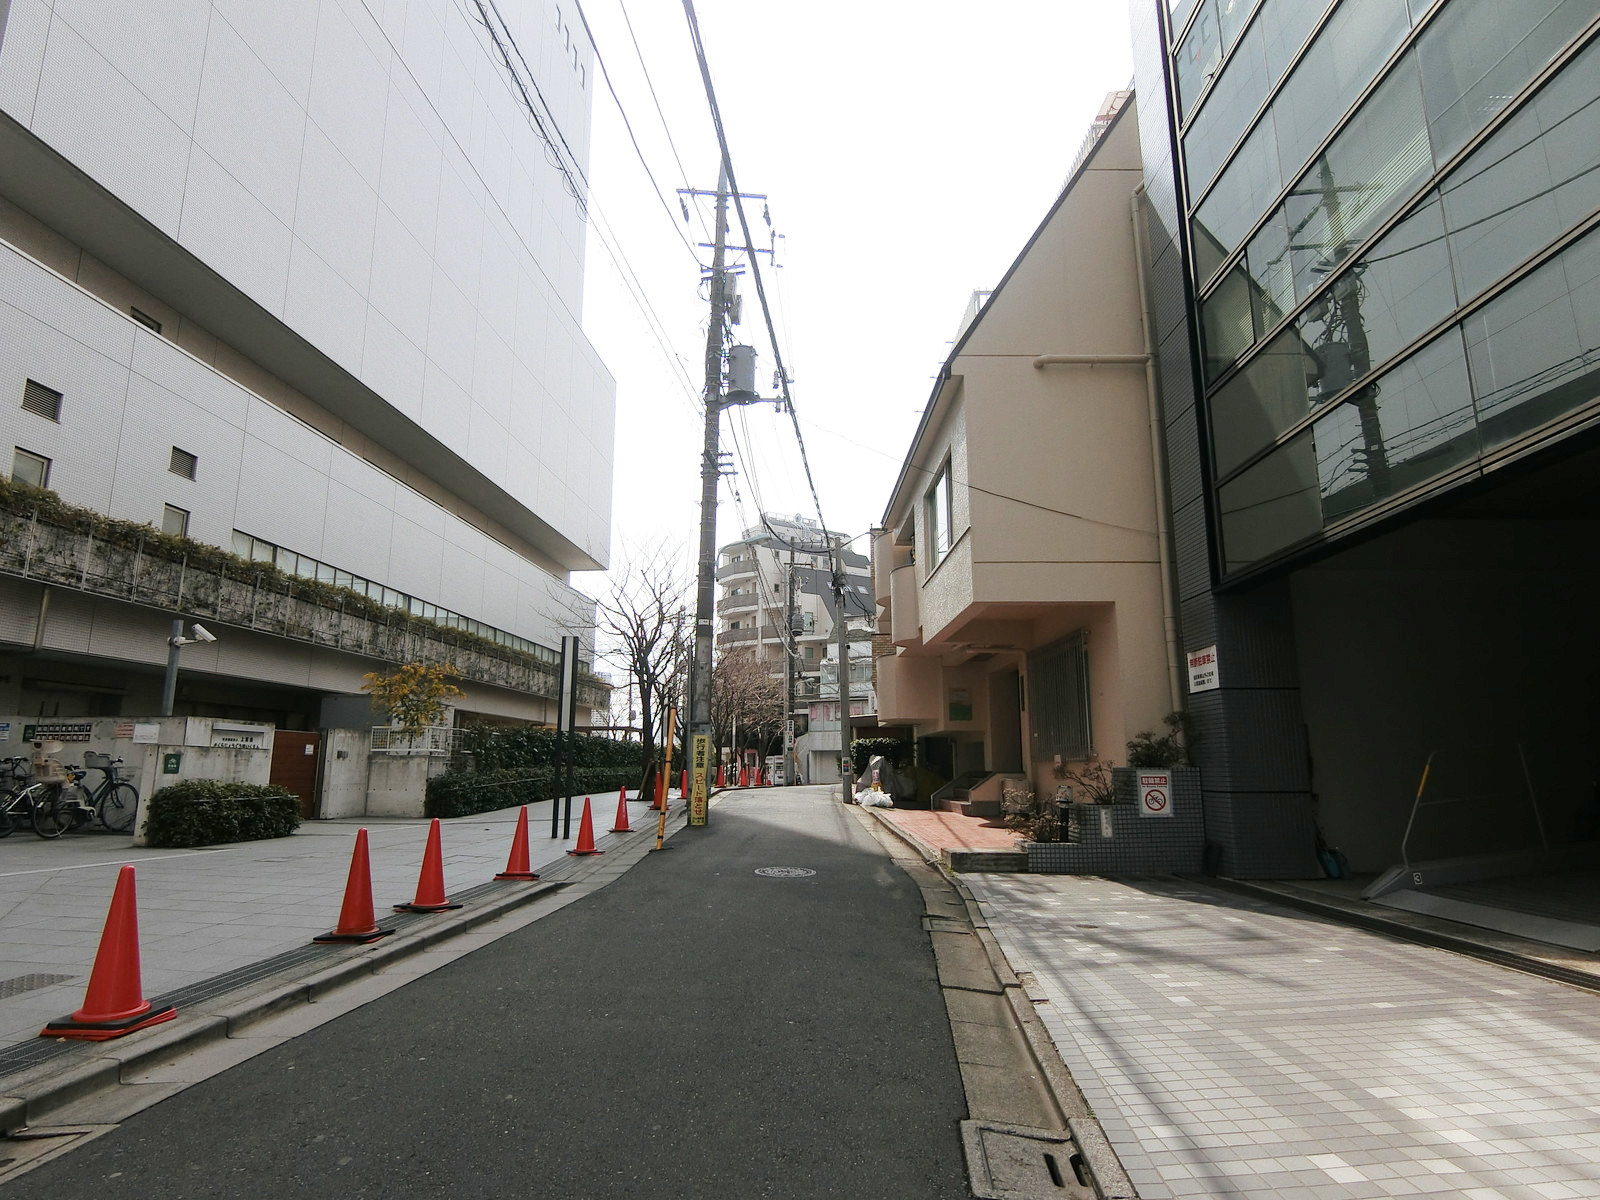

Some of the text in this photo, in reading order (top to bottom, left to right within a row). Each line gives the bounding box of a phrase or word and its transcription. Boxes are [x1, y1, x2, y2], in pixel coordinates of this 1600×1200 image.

[696, 739, 705, 768] 歩行者注意
[695, 773, 703, 815] スピード落とせ
[1415, 874, 1421, 883] 3
